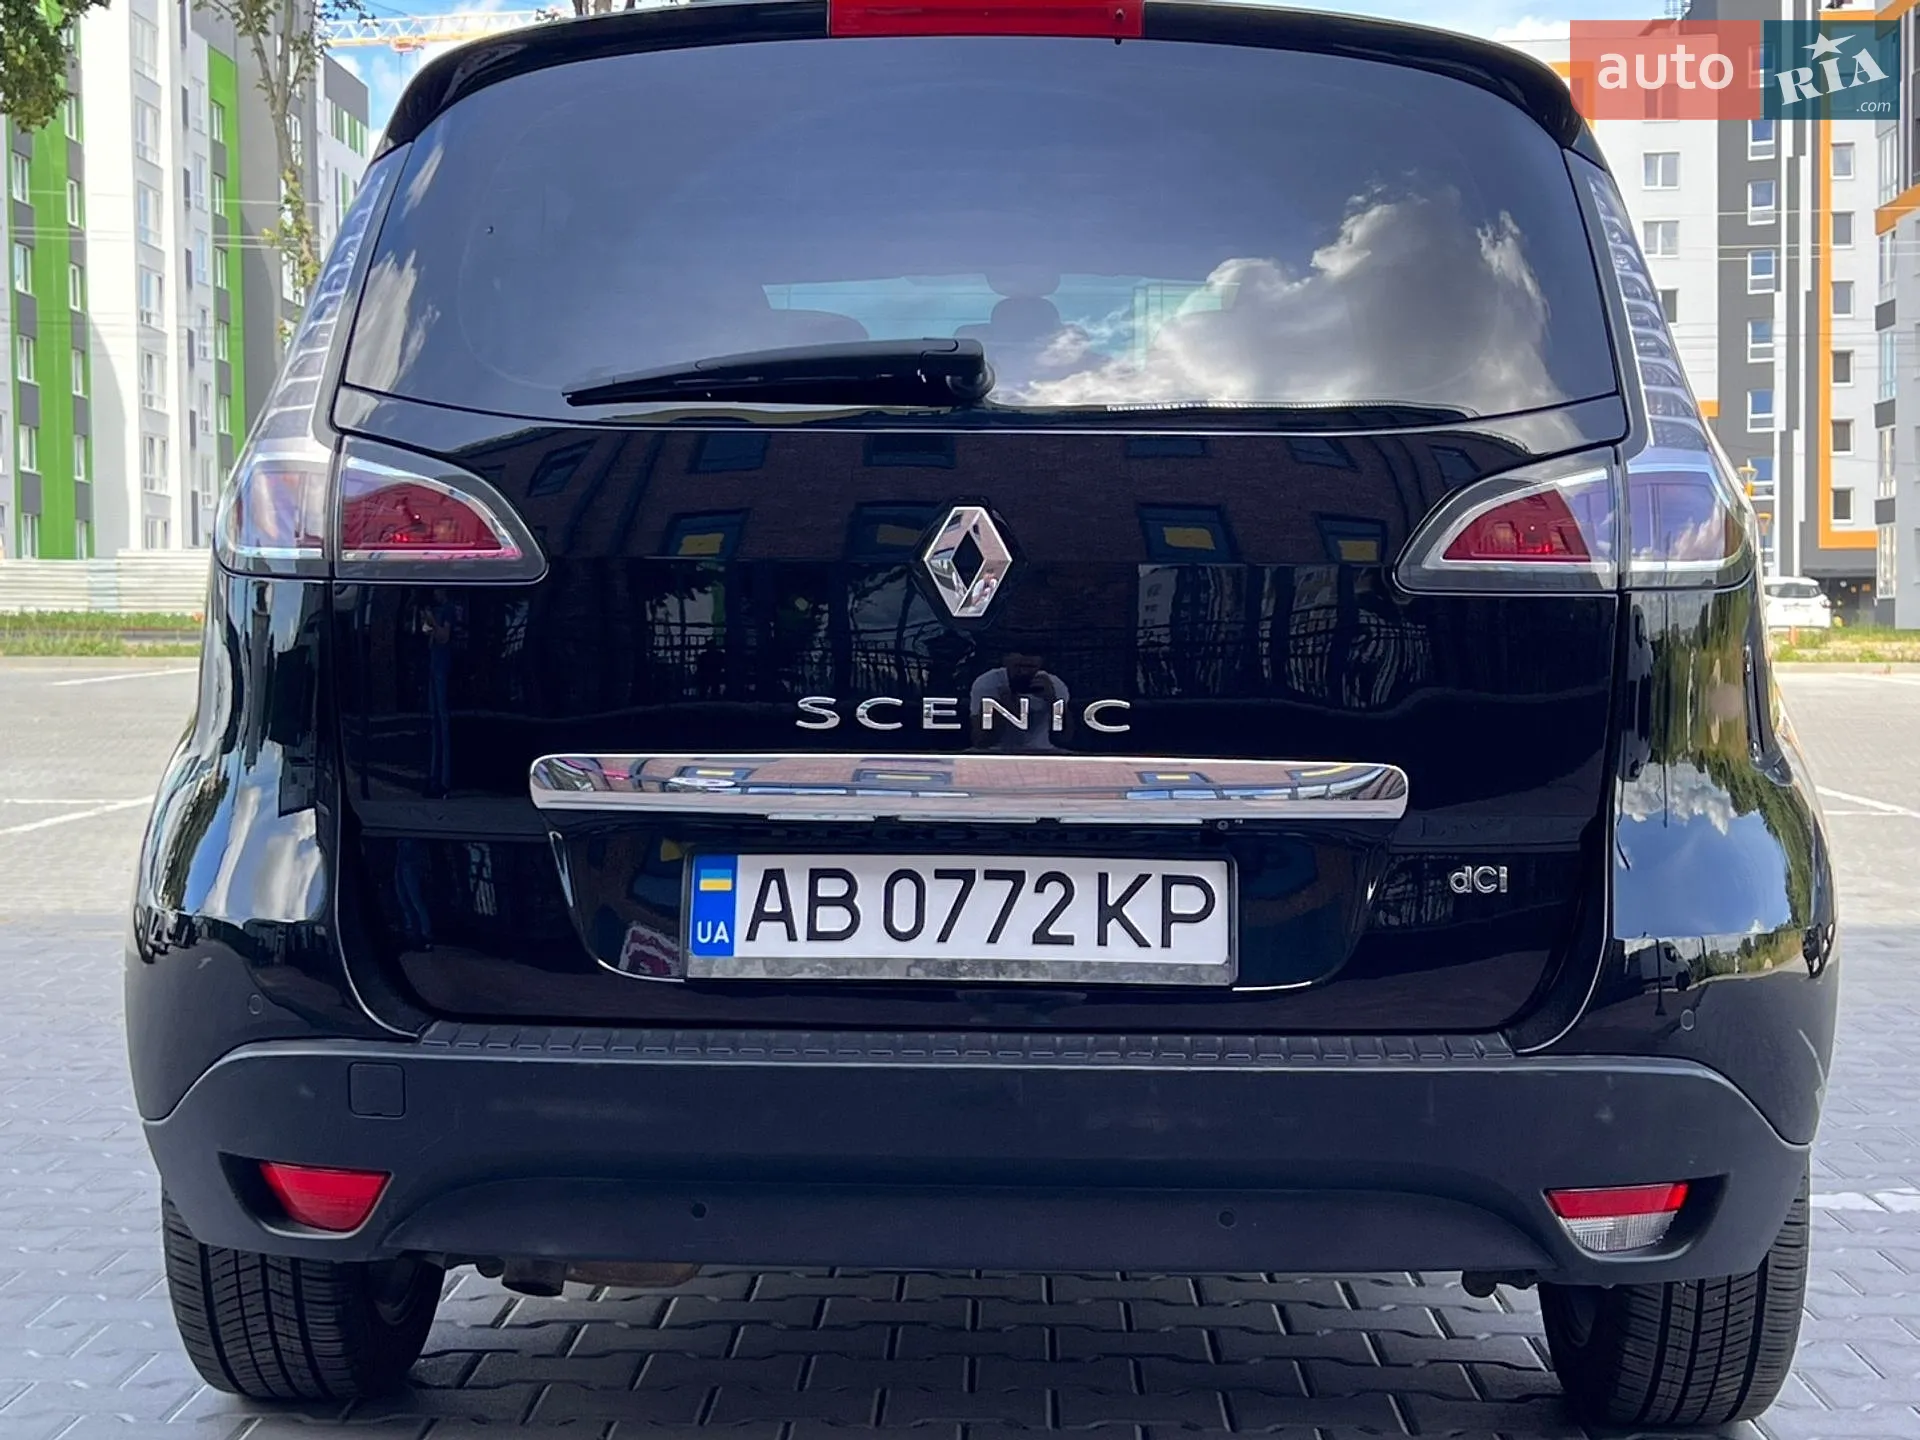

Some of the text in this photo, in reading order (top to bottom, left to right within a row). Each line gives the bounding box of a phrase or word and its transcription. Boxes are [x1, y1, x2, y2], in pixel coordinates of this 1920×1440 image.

[796, 696, 1131, 732] SCENIC
[745, 867, 1216, 948] AB 0772 KP
[696, 923, 730, 944] UA
